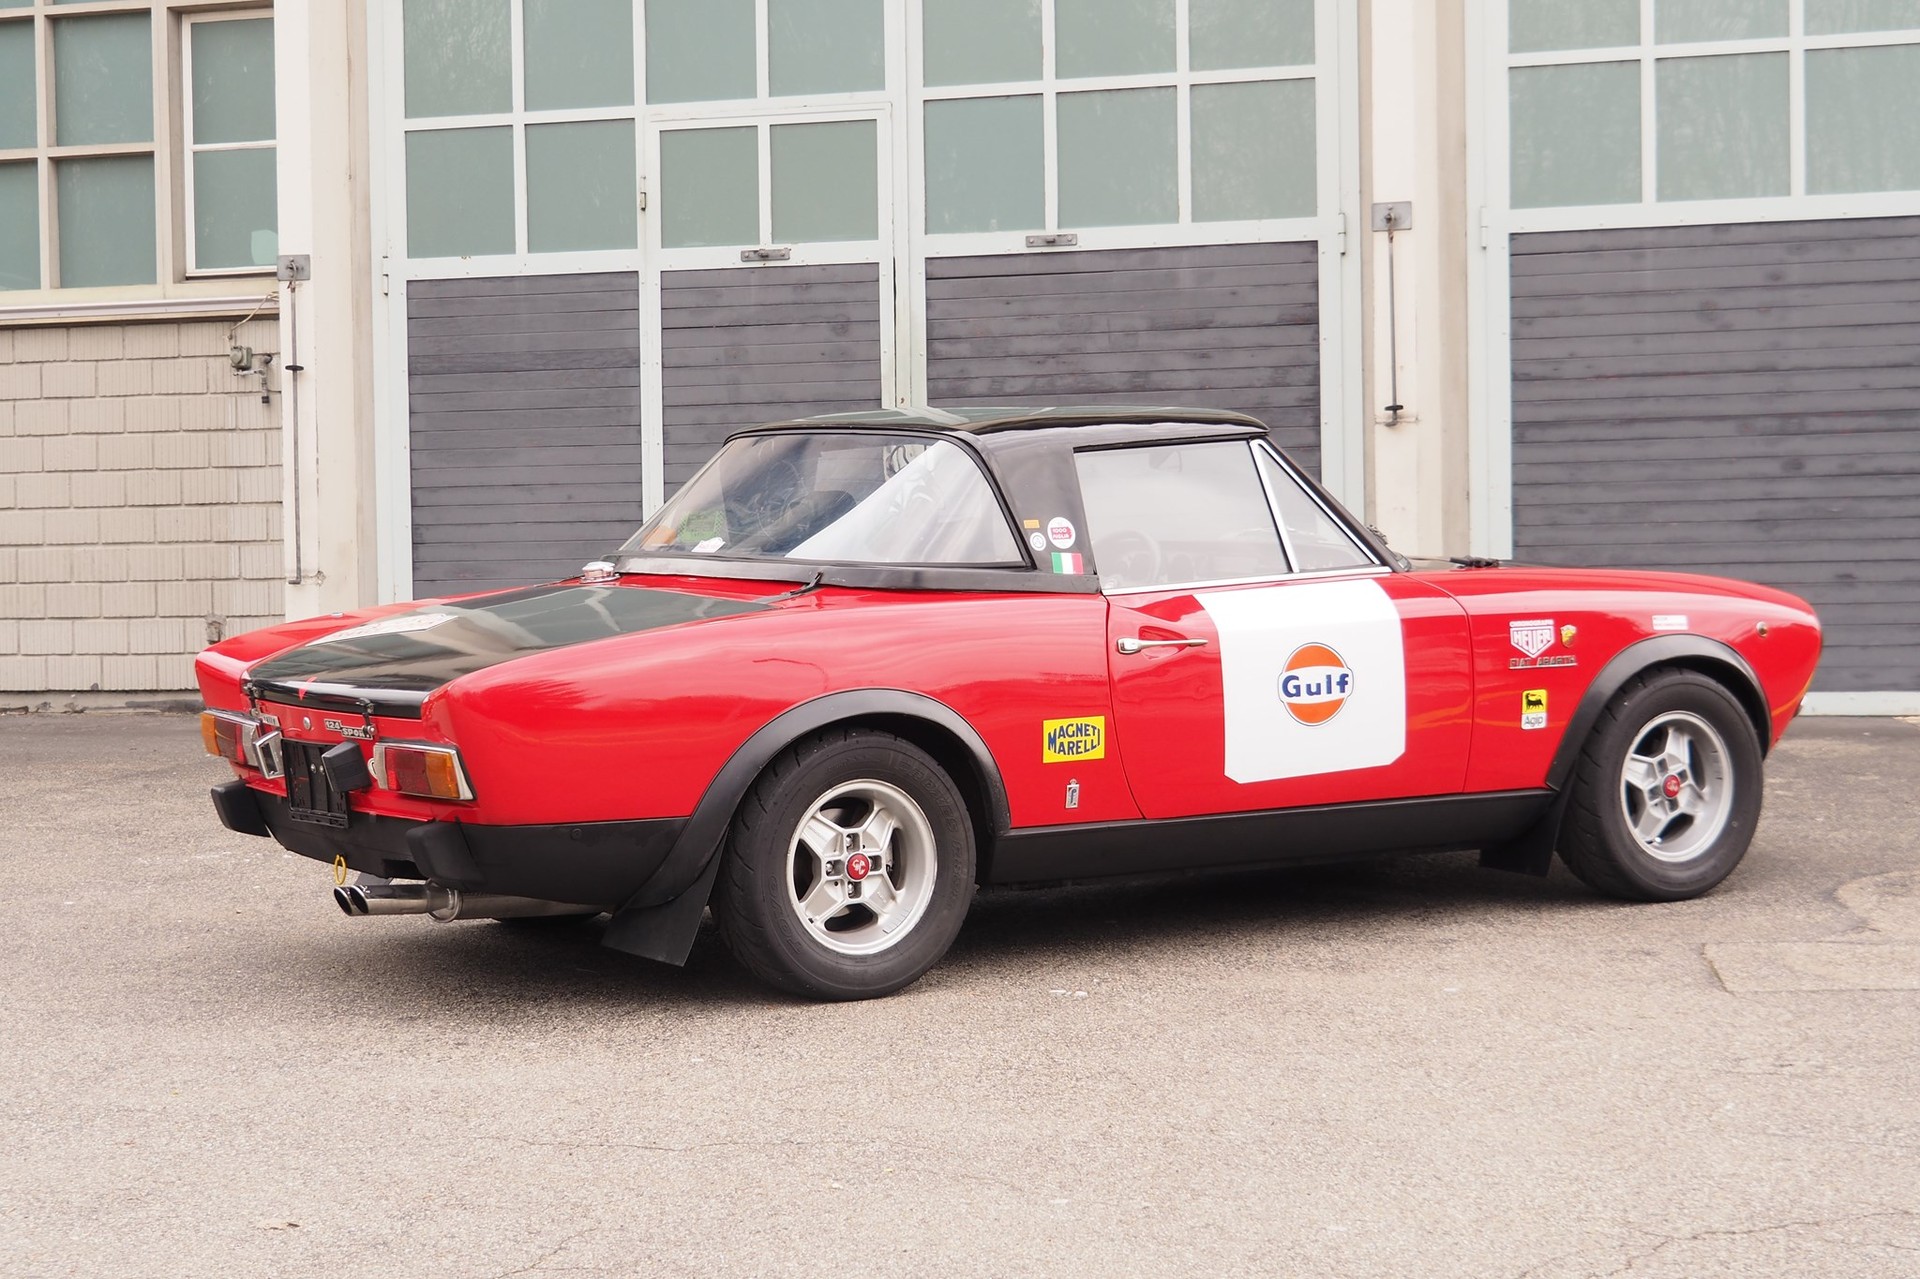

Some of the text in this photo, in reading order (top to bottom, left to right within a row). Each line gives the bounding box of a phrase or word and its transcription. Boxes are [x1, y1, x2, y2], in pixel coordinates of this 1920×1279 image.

[1509, 658, 1531, 667] FIAT
[1281, 673, 1349, 698] Gulf
[326, 720, 341, 730] 124
[1525, 716, 1544, 727] Agip
